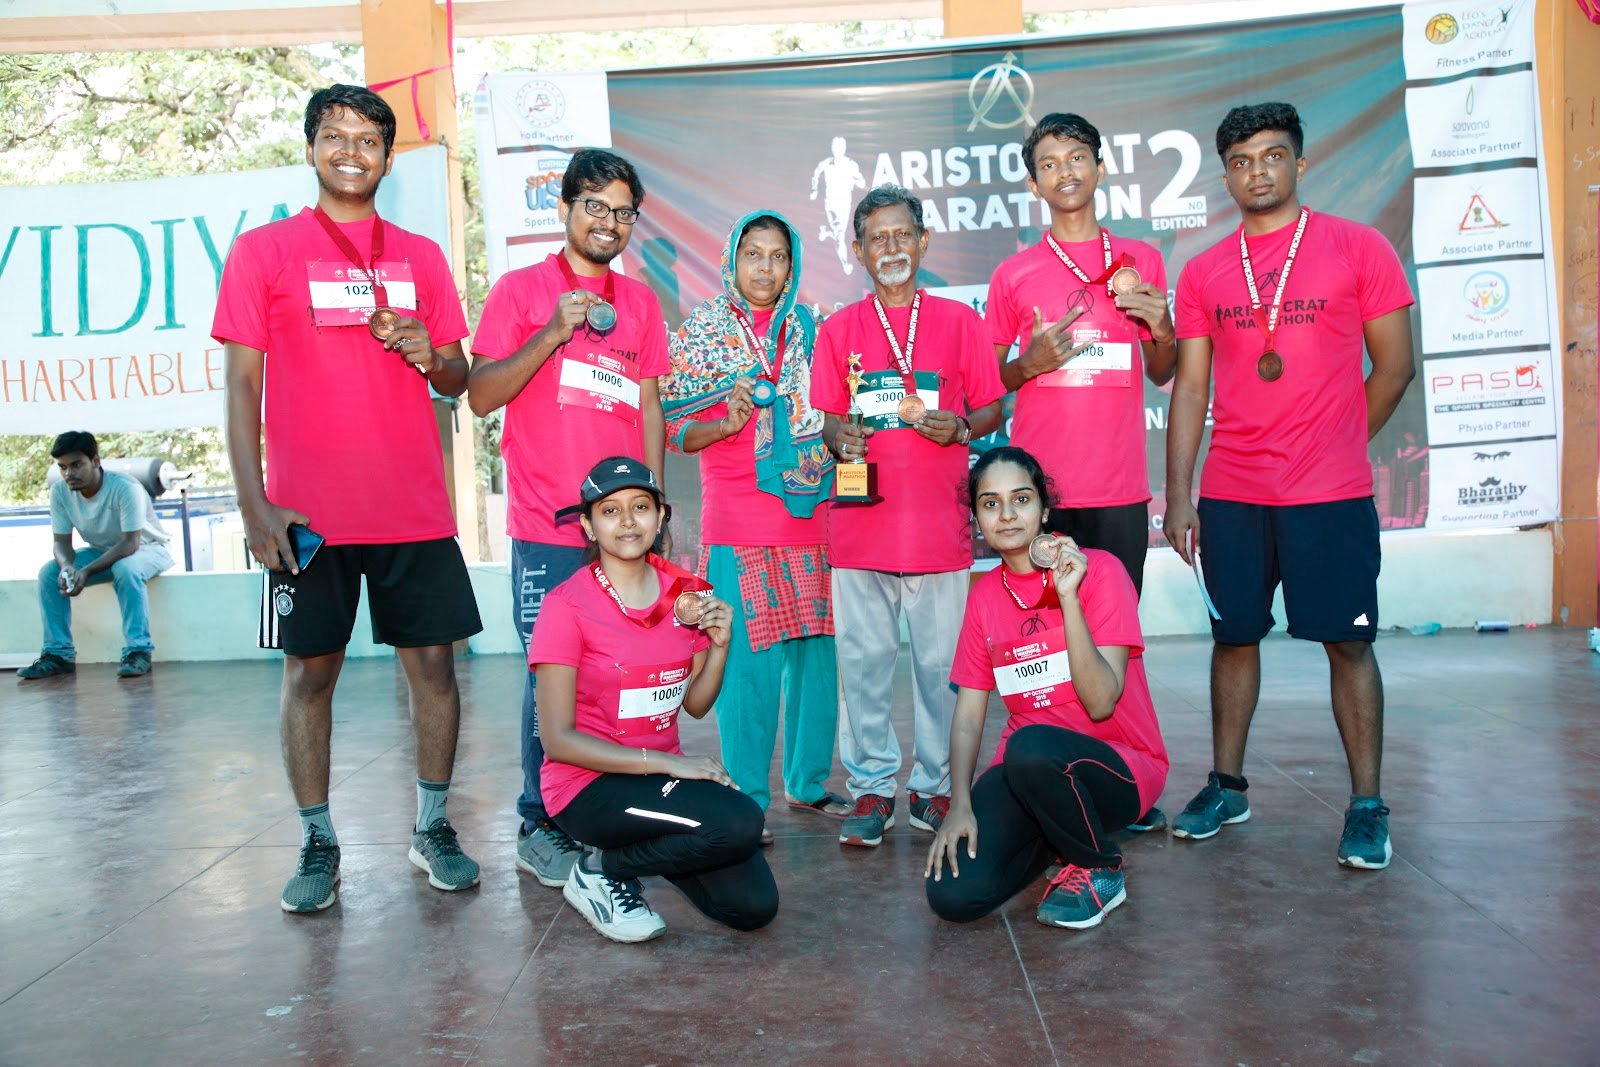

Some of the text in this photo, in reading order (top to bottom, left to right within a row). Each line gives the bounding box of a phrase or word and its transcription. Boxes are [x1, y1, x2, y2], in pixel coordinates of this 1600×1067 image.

[1436, 55, 1476, 68] Fitness
[1431, 141, 1522, 159] Associate Partner
[872, 130, 1207, 216] ARISTOAT 2 ND
[524, 217, 556, 229] Sports
[1151, 215, 1208, 231] EDITION
[1442, 240, 1533, 255] Associate Partner
[1242, 258, 1260, 305] ARISTOCRAT
[1272, 259, 1293, 306] MARATHON
[912, 293, 922, 308] 2019
[906, 306, 920, 344] MARATHON
[1268, 307, 1279, 331] 2019
[1452, 329, 1524, 342] Media Partner
[885, 327, 903, 360] MARATHON
[898, 356, 910, 375] 2019
[591, 369, 623, 388] 10006
[875, 391, 904, 403] 3000
[1451, 403, 1480, 411] SPORTS
[1482, 401, 1520, 409] SPECIALITY
[1458, 420, 1531, 434] Physio Partner
[1458, 482, 1527, 498] Bharathy
[1503, 509, 1539, 519] Partner
[520, 564, 547, 623] DEPT.
[1014, 660, 1049, 679] 10007
[651, 684, 683, 702] 10005
[1031, 687, 1055, 698] OCTOBER
[1041, 700, 1052, 708] KM
